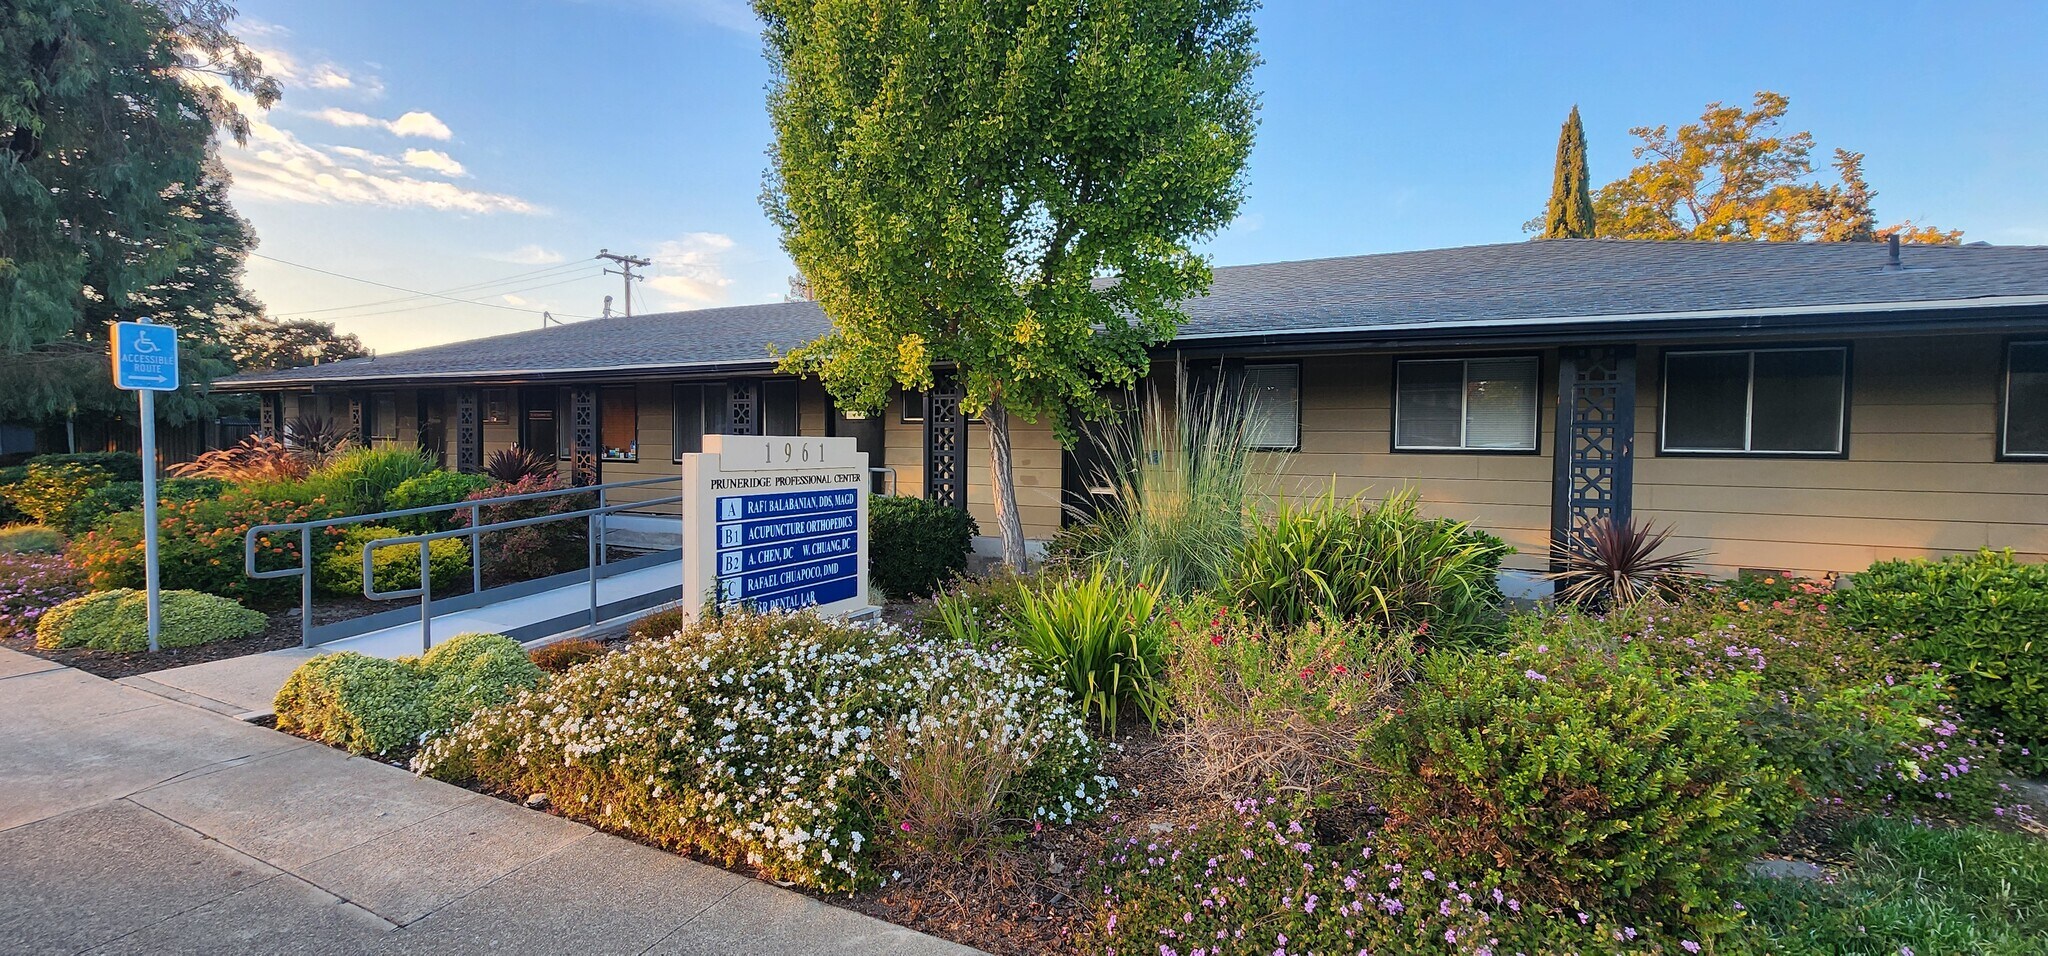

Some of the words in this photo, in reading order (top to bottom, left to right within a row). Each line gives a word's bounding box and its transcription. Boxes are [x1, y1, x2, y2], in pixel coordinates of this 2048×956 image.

[121, 354, 174, 365] ACCESSIBLE
[134, 364, 162, 373] ROUTE
[711, 477, 771, 490] PRUNERIDGE
[775, 474, 831, 487] PROFESSIONAL
[834, 473, 861, 483] CENTER
[728, 502, 736, 517] A
[748, 499, 767, 514] RAFI
[769, 497, 818, 512] BALABANIAN,
[819, 496, 833, 508] DDS,
[835, 493, 854, 506] MAGD
[725, 528, 739, 543] B1
[748, 522, 805, 540] ACUPUNCTURE
[806, 516, 853, 533] ORTHOPEDICS
[725, 555, 739, 571] B2
[748, 553, 757, 565] A.
[758, 548, 782, 563] CHEN,
[783, 546, 794, 560] DC
[803, 544, 811, 556] W.
[812, 539, 842, 555] CHUANG,
[842, 537, 851, 550] DC
[728, 580, 736, 596] C
[748, 576, 778, 592] RAFAEL
[779, 566, 823, 584] CHUAPOCO,
[823, 562, 839, 576] DMD
